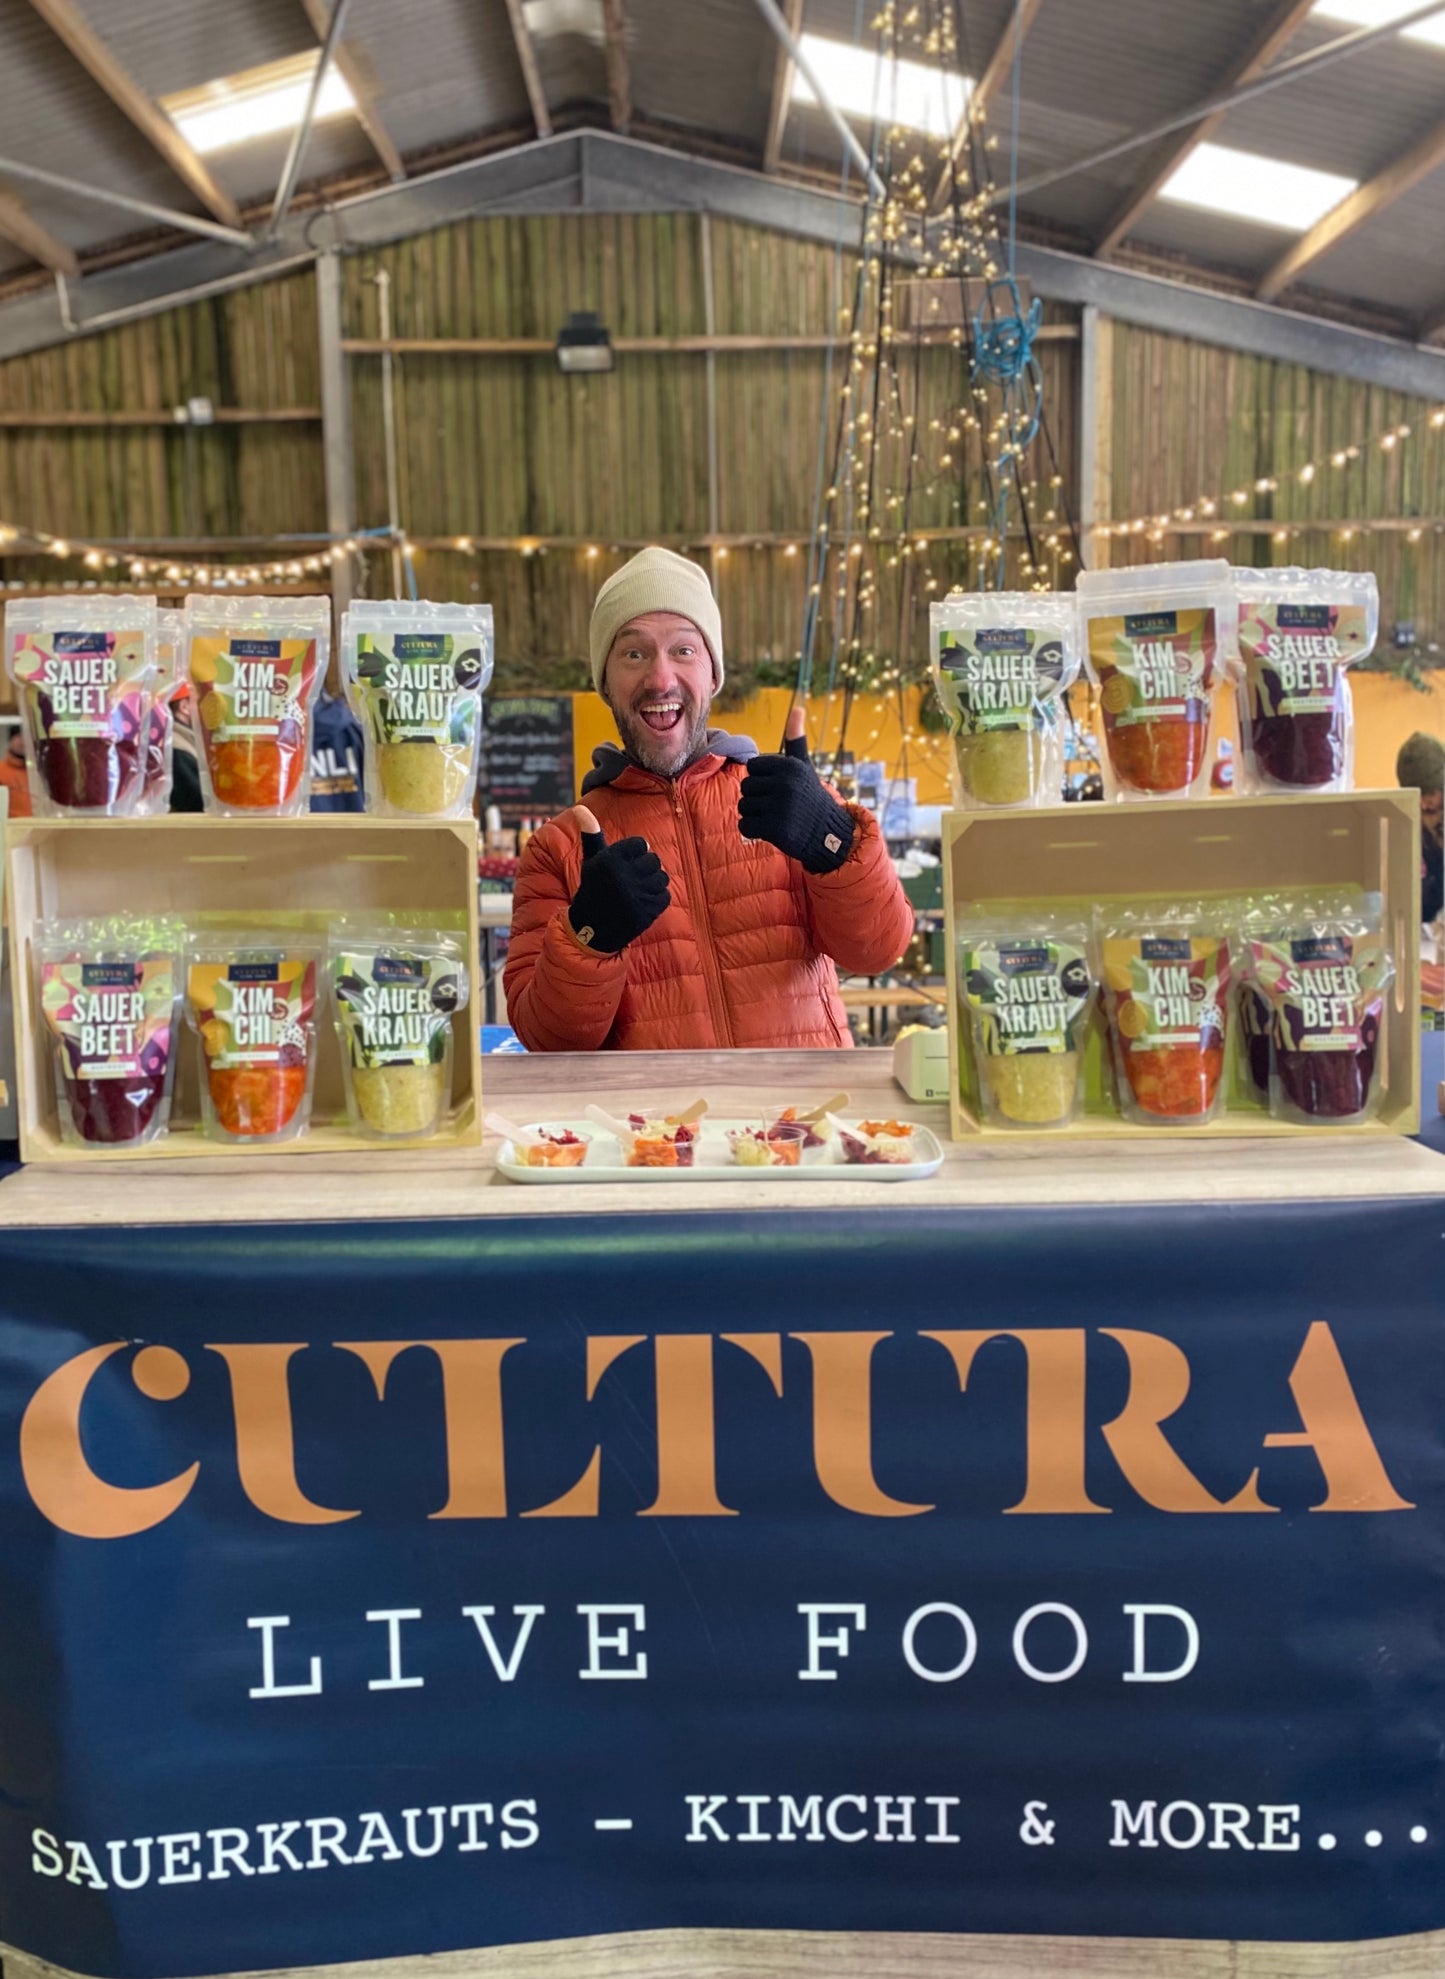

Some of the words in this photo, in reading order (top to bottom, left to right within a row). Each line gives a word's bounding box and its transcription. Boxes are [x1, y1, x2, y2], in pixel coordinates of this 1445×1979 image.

[1132, 641, 1176, 668] KIM
[1267, 634, 1341, 660] SAUER
[43, 658, 117, 685] SAUER
[233, 662, 275, 688] KIM
[385, 663, 455, 690] SAUER
[966, 655, 1036, 681] SAUER
[1281, 659, 1335, 691] BEET
[967, 681, 1040, 711] KRAUT
[1140, 669, 1177, 699] CHI
[52, 685, 109, 714] BEET
[235, 689, 271, 718] CHI
[386, 690, 457, 721] KRAUT
[993, 975, 1064, 1004] SAUER
[1147, 966, 1190, 995] KIM
[1285, 965, 1361, 996] SAUER
[71, 992, 145, 1024] SAUER
[232, 987, 274, 1014] KIM
[363, 986, 432, 1015] SAUER
[1153, 996, 1192, 1027] CHI
[1301, 996, 1355, 1028] BEET
[234, 1015, 270, 1045] CHI
[363, 1014, 433, 1047] KRAUT
[996, 1002, 1068, 1033] KRAUT
[80, 1024, 137, 1056] BEET
[19, 1321, 1417, 1539] CULTURA
[247, 1603, 647, 1699] LIVE
[798, 1602, 1200, 1683] FOOD
[31, 1800, 541, 1890] SAUERKRAUTS
[685, 1796, 961, 1843] KIMCHI
[1019, 1802, 1055, 1846] &
